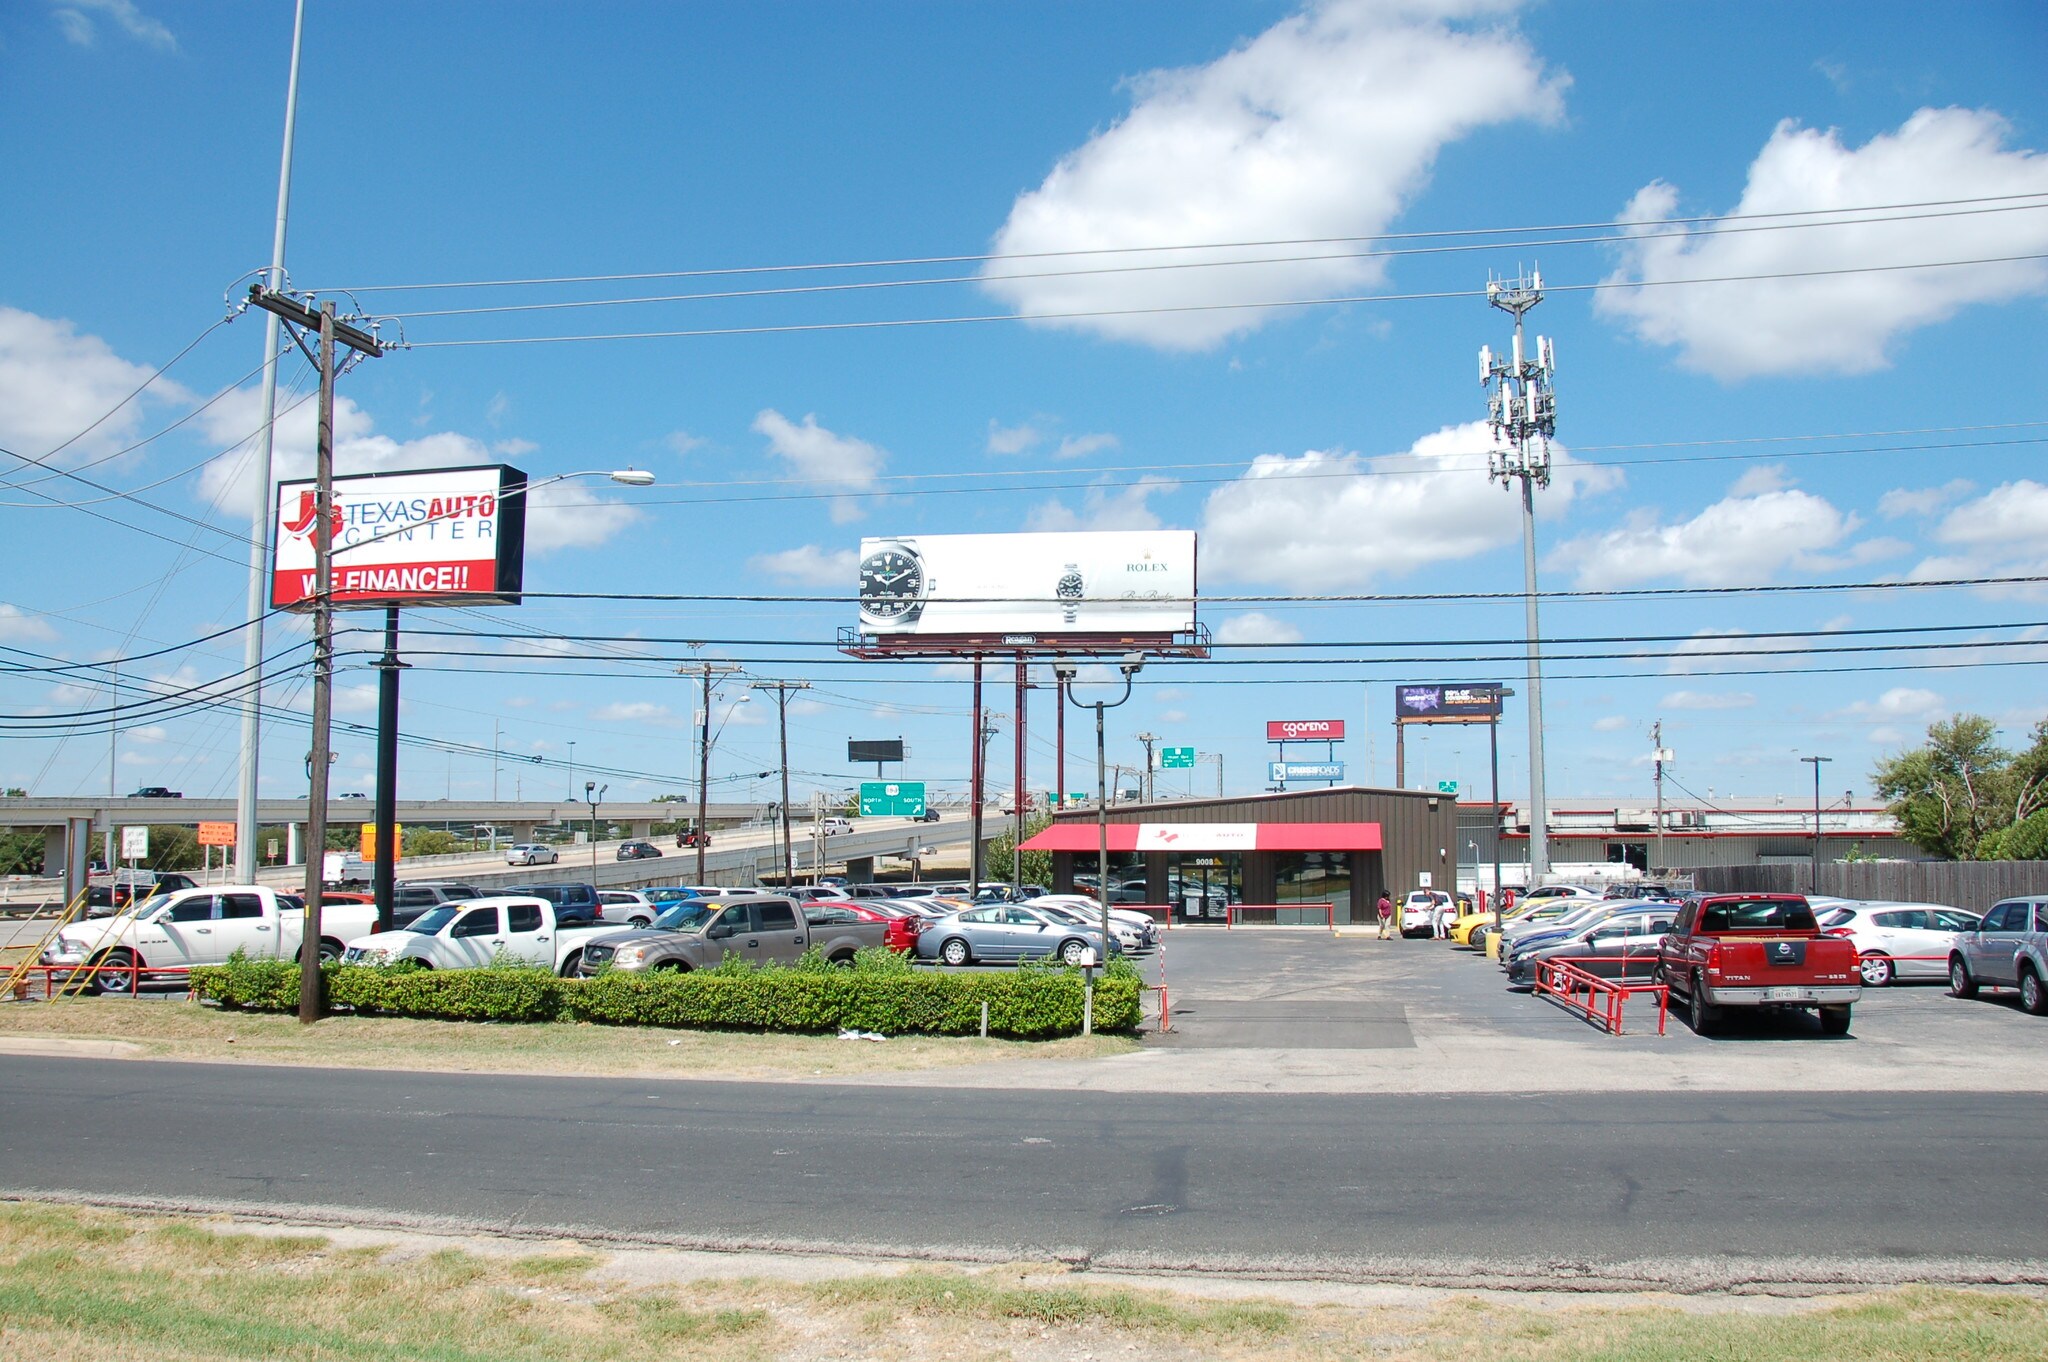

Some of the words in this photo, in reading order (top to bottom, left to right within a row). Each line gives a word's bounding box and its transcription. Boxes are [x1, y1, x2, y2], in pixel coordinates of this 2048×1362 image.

[345, 520, 492, 545] CENTER
[1126, 563, 1168, 572] ROLEX
[345, 566, 469, 593] FINANCE!!
[907, 579, 916, 587] 3
